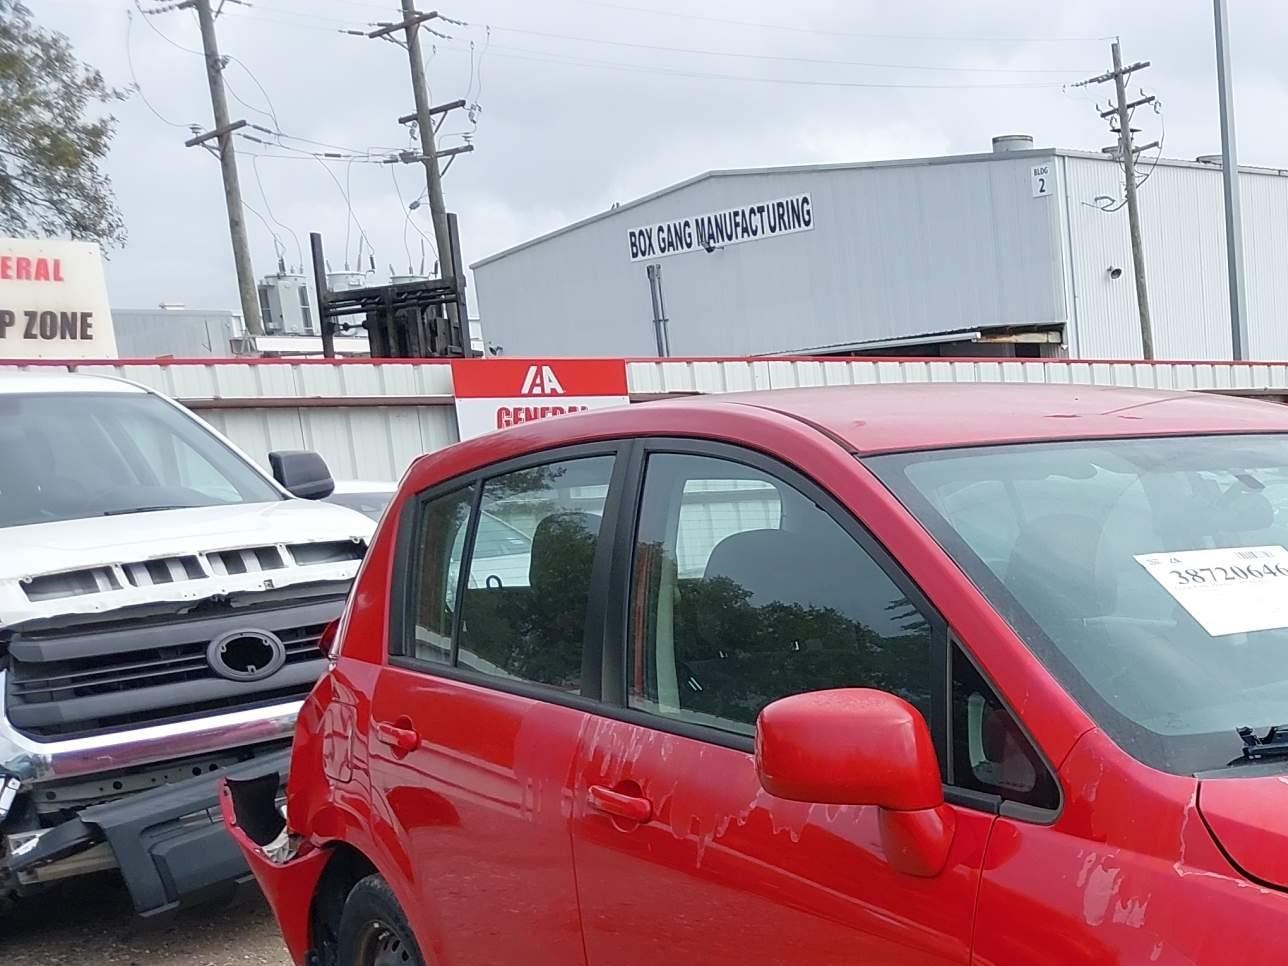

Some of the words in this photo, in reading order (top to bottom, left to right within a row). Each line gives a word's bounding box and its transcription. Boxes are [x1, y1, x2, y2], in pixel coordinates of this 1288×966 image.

[1039, 178, 1046, 193] 2
[629, 228, 656, 259] BOX
[657, 220, 693, 254] GANG
[695, 196, 812, 247] MANUFACTURING
[23, 310, 93, 340] ZONE
[496, 406, 589, 430] GENE
